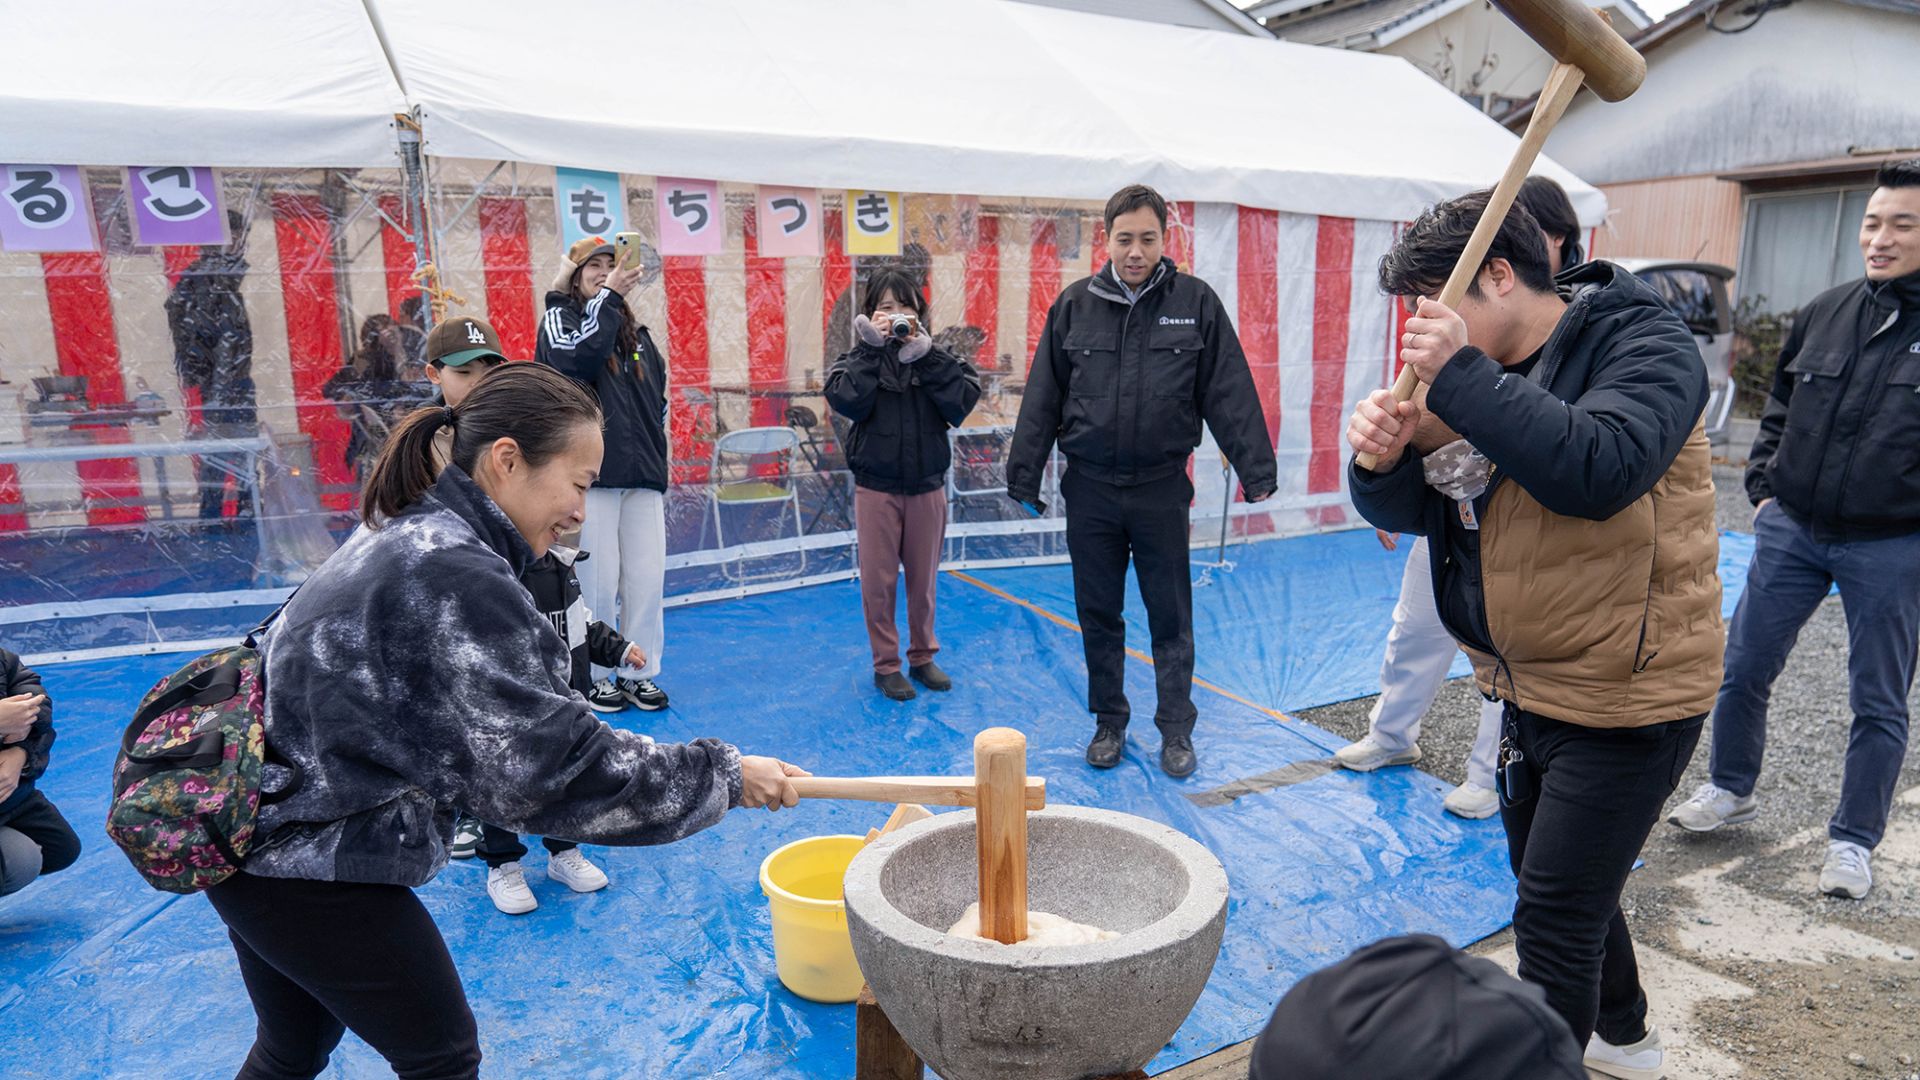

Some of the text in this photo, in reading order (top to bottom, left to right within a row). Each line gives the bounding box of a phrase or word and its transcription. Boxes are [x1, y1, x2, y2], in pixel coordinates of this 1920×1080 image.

[571, 189, 890, 234] もちつき
[465, 321, 486, 344] LA
